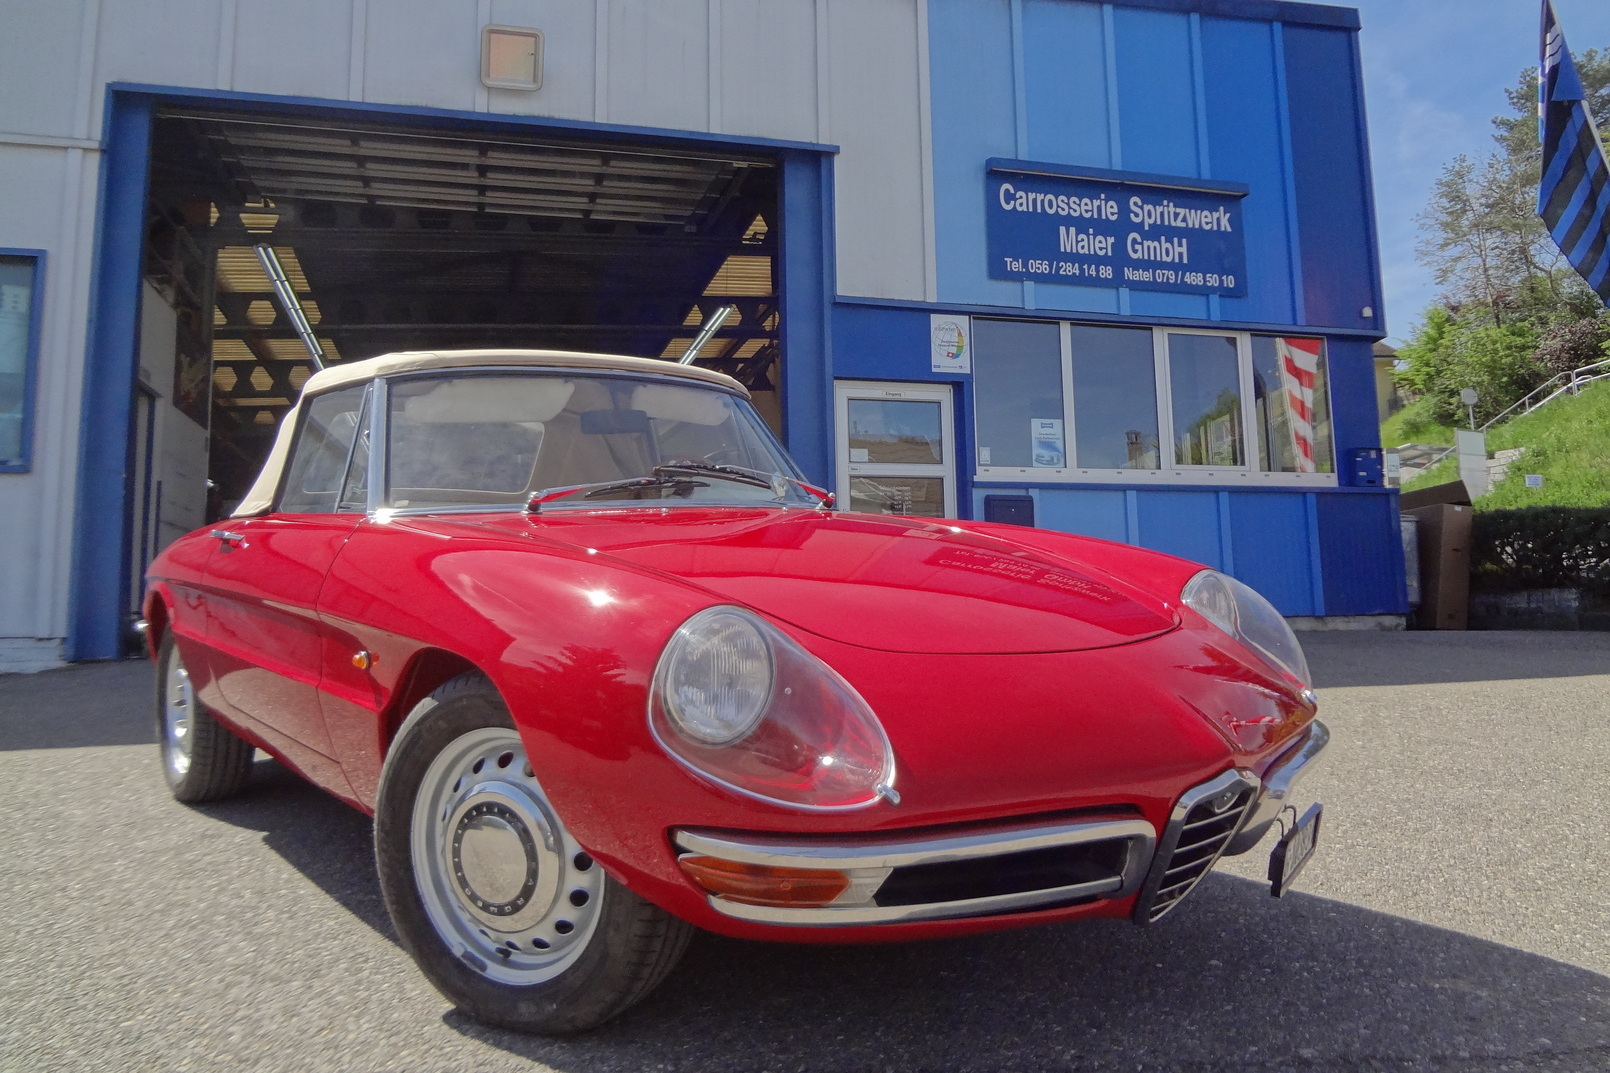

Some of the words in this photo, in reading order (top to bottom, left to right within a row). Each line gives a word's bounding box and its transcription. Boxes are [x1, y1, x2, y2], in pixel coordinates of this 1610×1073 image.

[999, 183, 1119, 221] Carrosserie
[1129, 196, 1233, 232] Spritzwerk
[1059, 226, 1115, 256] Maier
[1127, 232, 1188, 264] GmbH
[1004, 258, 1026, 272] Tel.
[1028, 260, 1049, 274] 056
[1052, 261, 1056, 274] /
[1059, 262, 1080, 276] 284
[1083, 264, 1097, 277] 14
[1099, 265, 1113, 279] 88
[1124, 267, 1153, 281] Natel
[1156, 269, 1175, 283] 079
[1177, 271, 1182, 284] /
[1184, 272, 1203, 286] 468
[1206, 274, 1219, 287] 50
[1221, 275, 1235, 288] 10
